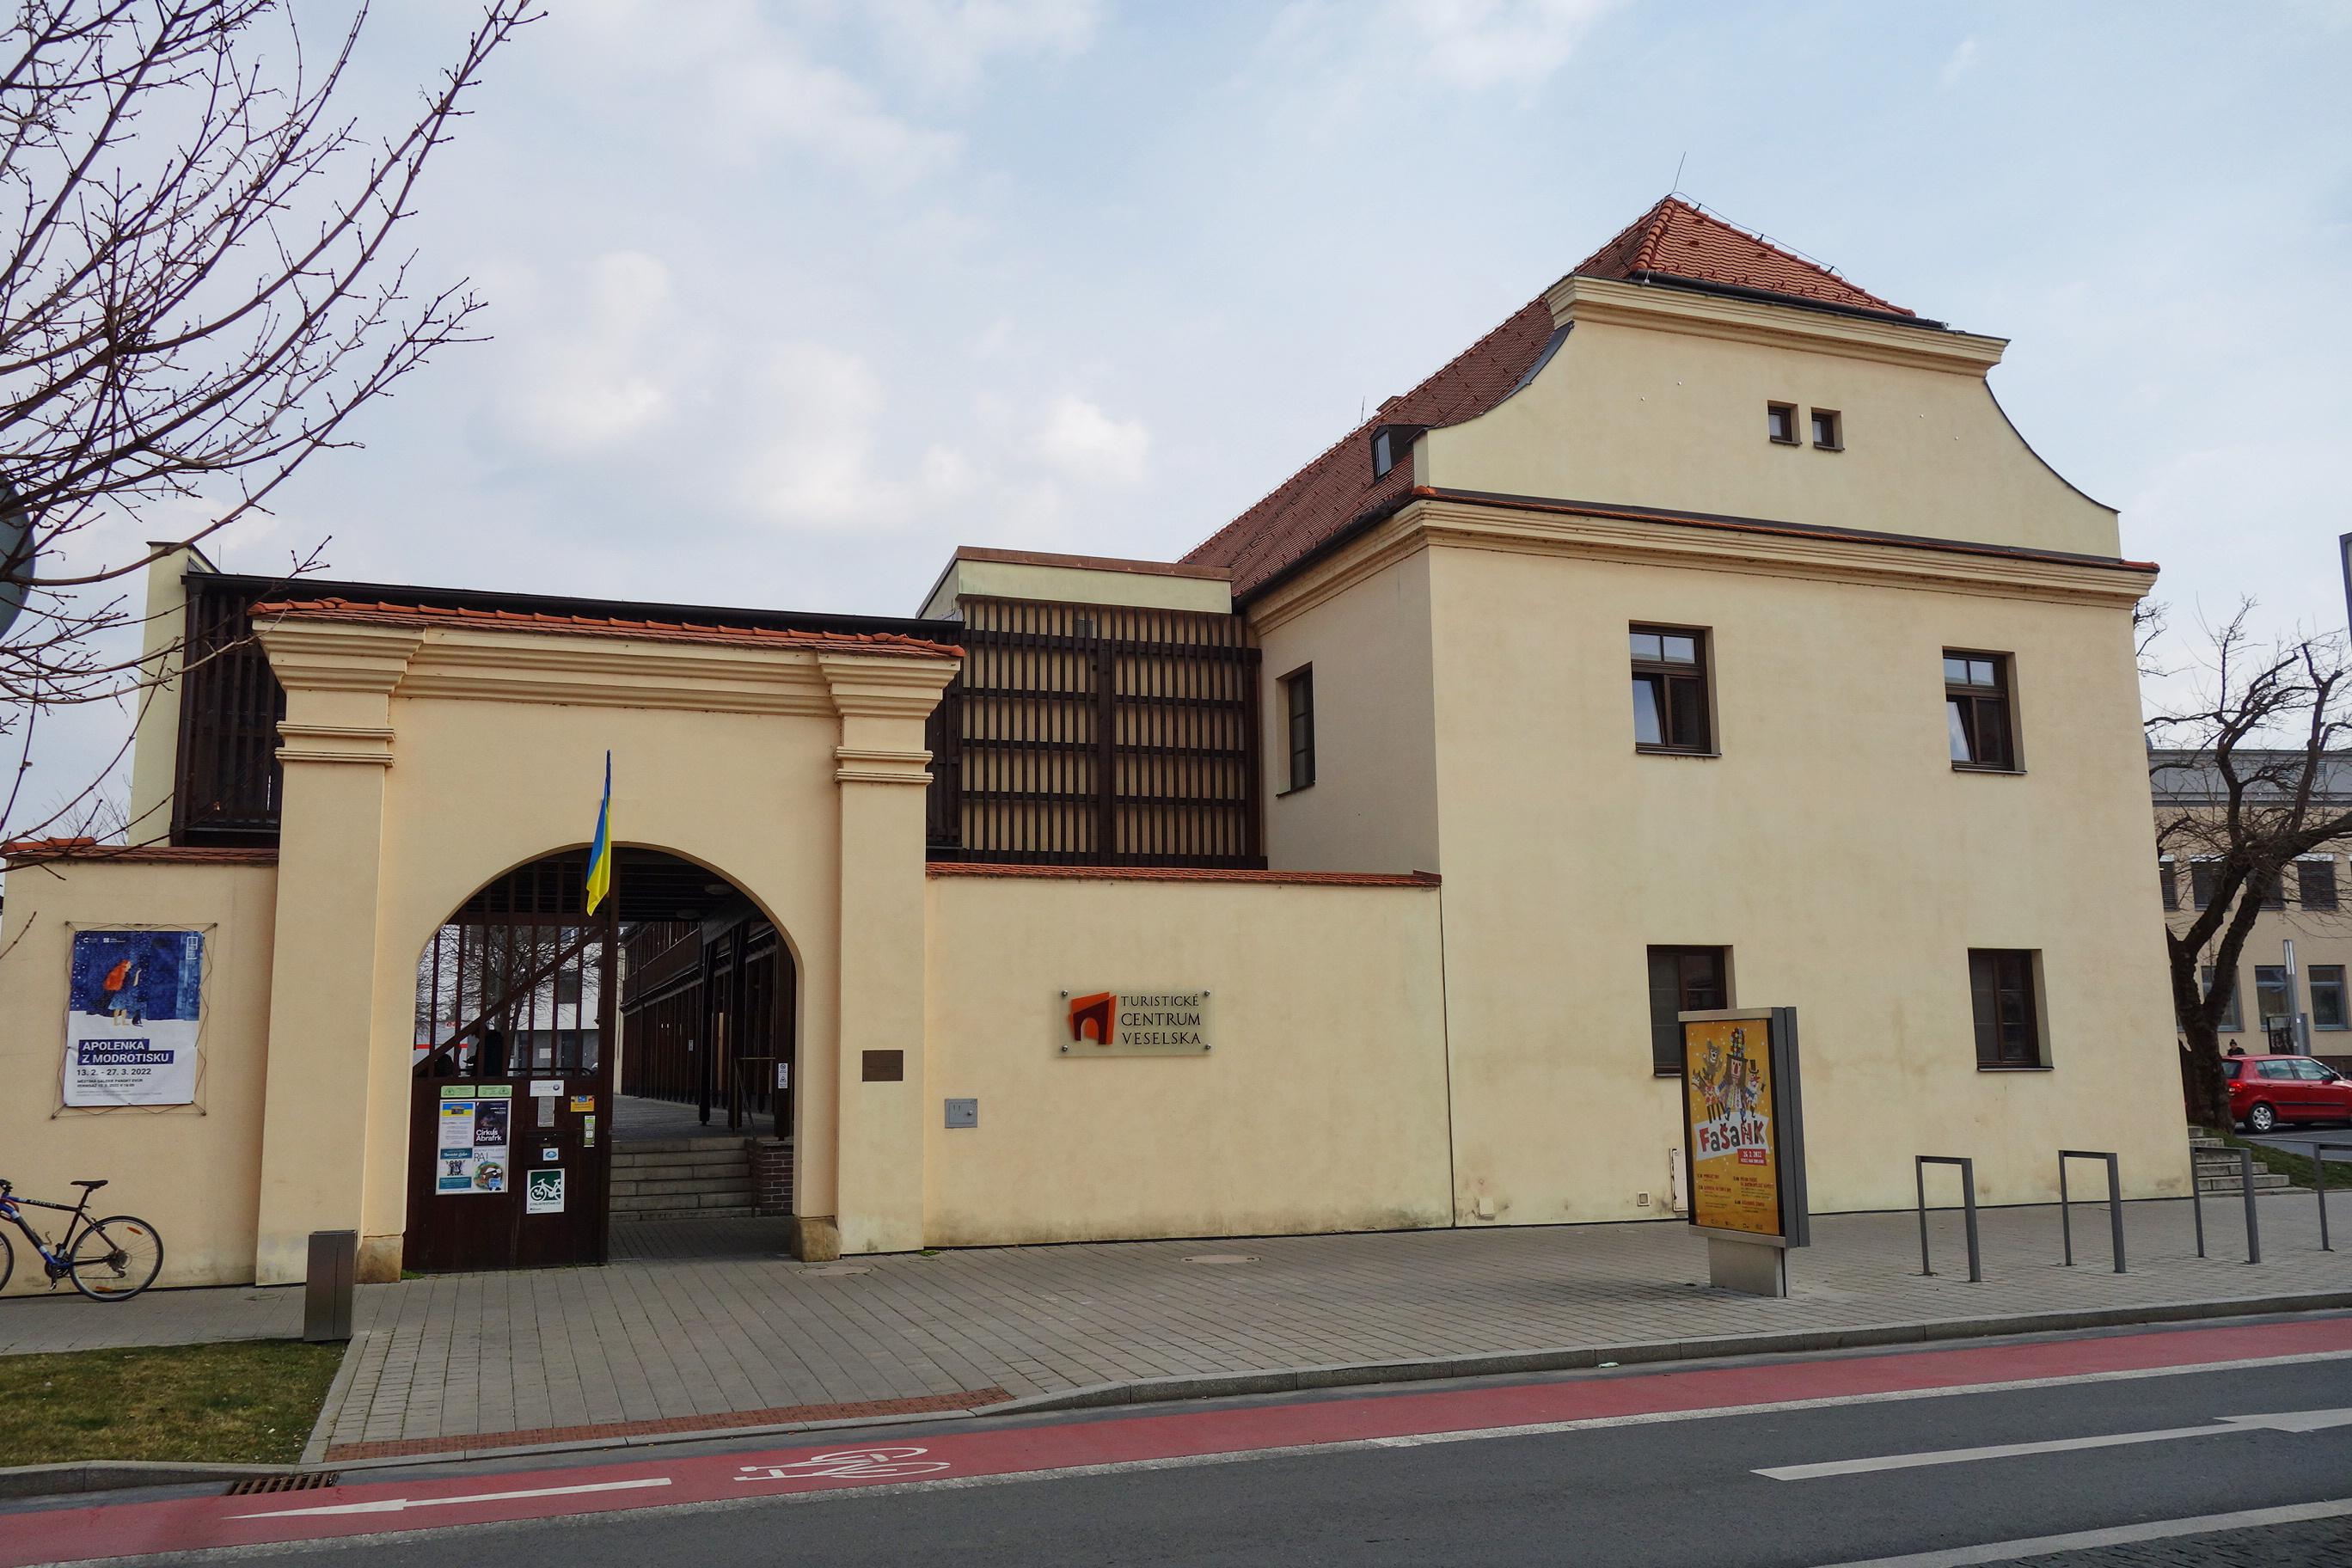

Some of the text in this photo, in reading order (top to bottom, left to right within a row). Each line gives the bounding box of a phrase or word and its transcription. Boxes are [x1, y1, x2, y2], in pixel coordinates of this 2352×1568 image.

[1120, 994, 1199, 1007] TURISTICKÉ
[1121, 1013, 1201, 1026] CENTRUM
[1122, 1032, 1202, 1045] VESELSKA
[82, 1041, 145, 1051] APOLENKA
[82, 1053, 169, 1063] Z MODROTISKU
